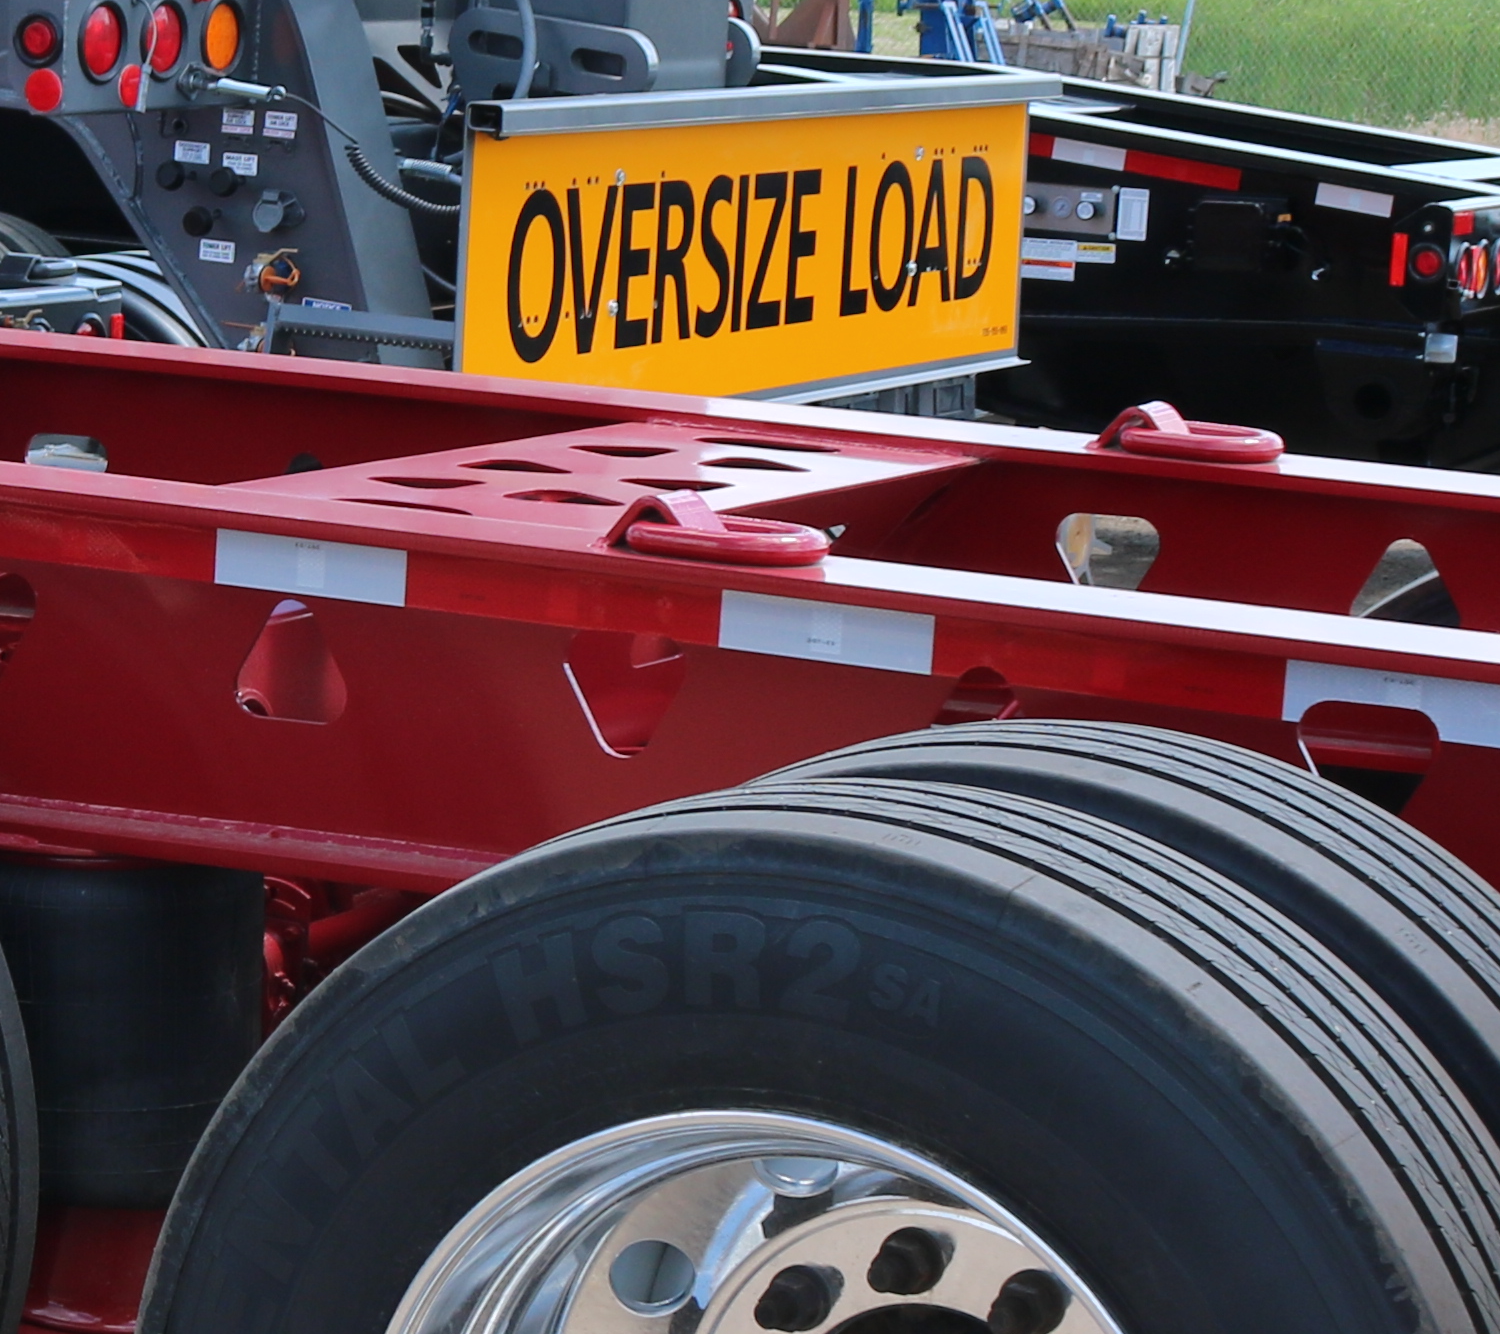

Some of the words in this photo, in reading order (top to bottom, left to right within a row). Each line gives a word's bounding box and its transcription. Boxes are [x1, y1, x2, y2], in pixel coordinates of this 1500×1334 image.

[506, 169, 822, 364] OVERSIZE
[838, 155, 994, 317] LOAD
[488, 907, 865, 1049] HSR2
[868, 961, 945, 1028] SA
